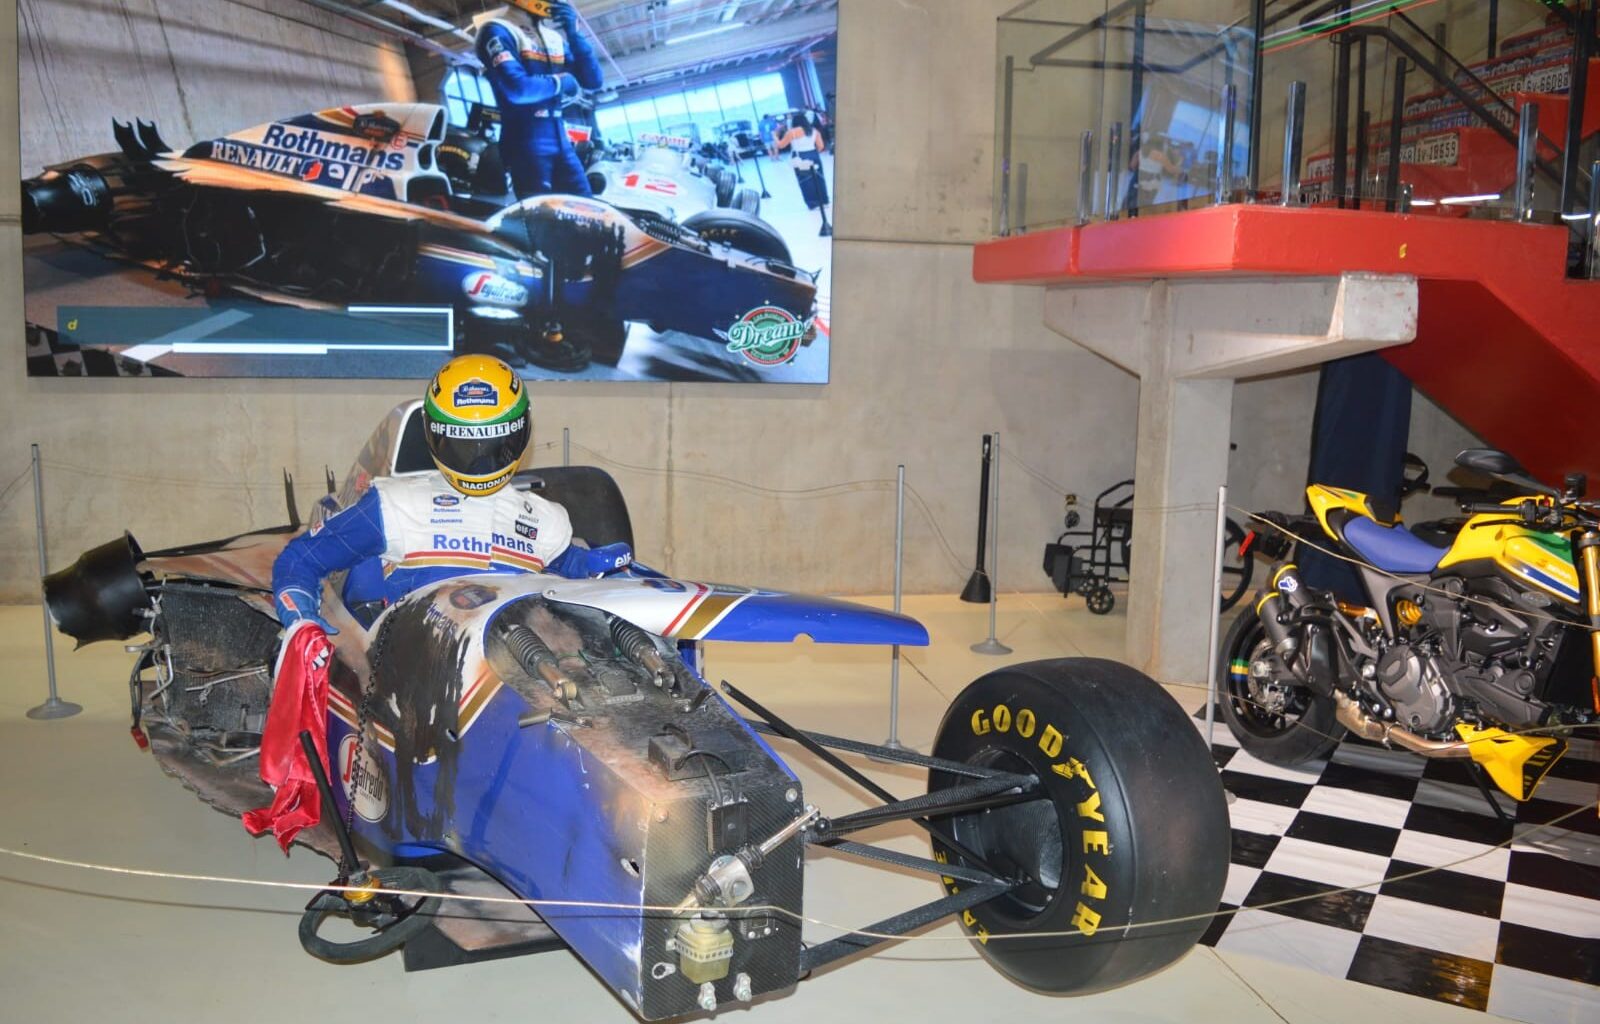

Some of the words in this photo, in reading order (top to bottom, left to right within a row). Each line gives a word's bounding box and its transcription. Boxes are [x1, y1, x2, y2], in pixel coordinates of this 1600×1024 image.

[262, 123, 405, 170] Rothmans
[210, 141, 302, 175] RENAULT
[623, 173, 678, 196] 12
[67, 318, 78, 331] d
[727, 320, 804, 352] Dream
[456, 398, 495, 406] Rothmans
[430, 422, 447, 434] elf
[449, 423, 507, 437] RENAULT
[510, 417, 525, 432] elf
[461, 473, 512, 490] NACIONAL
[516, 523, 529, 536] elf
[615, 552, 631, 568] elf
[971, 704, 1109, 936] GOODYEAR
